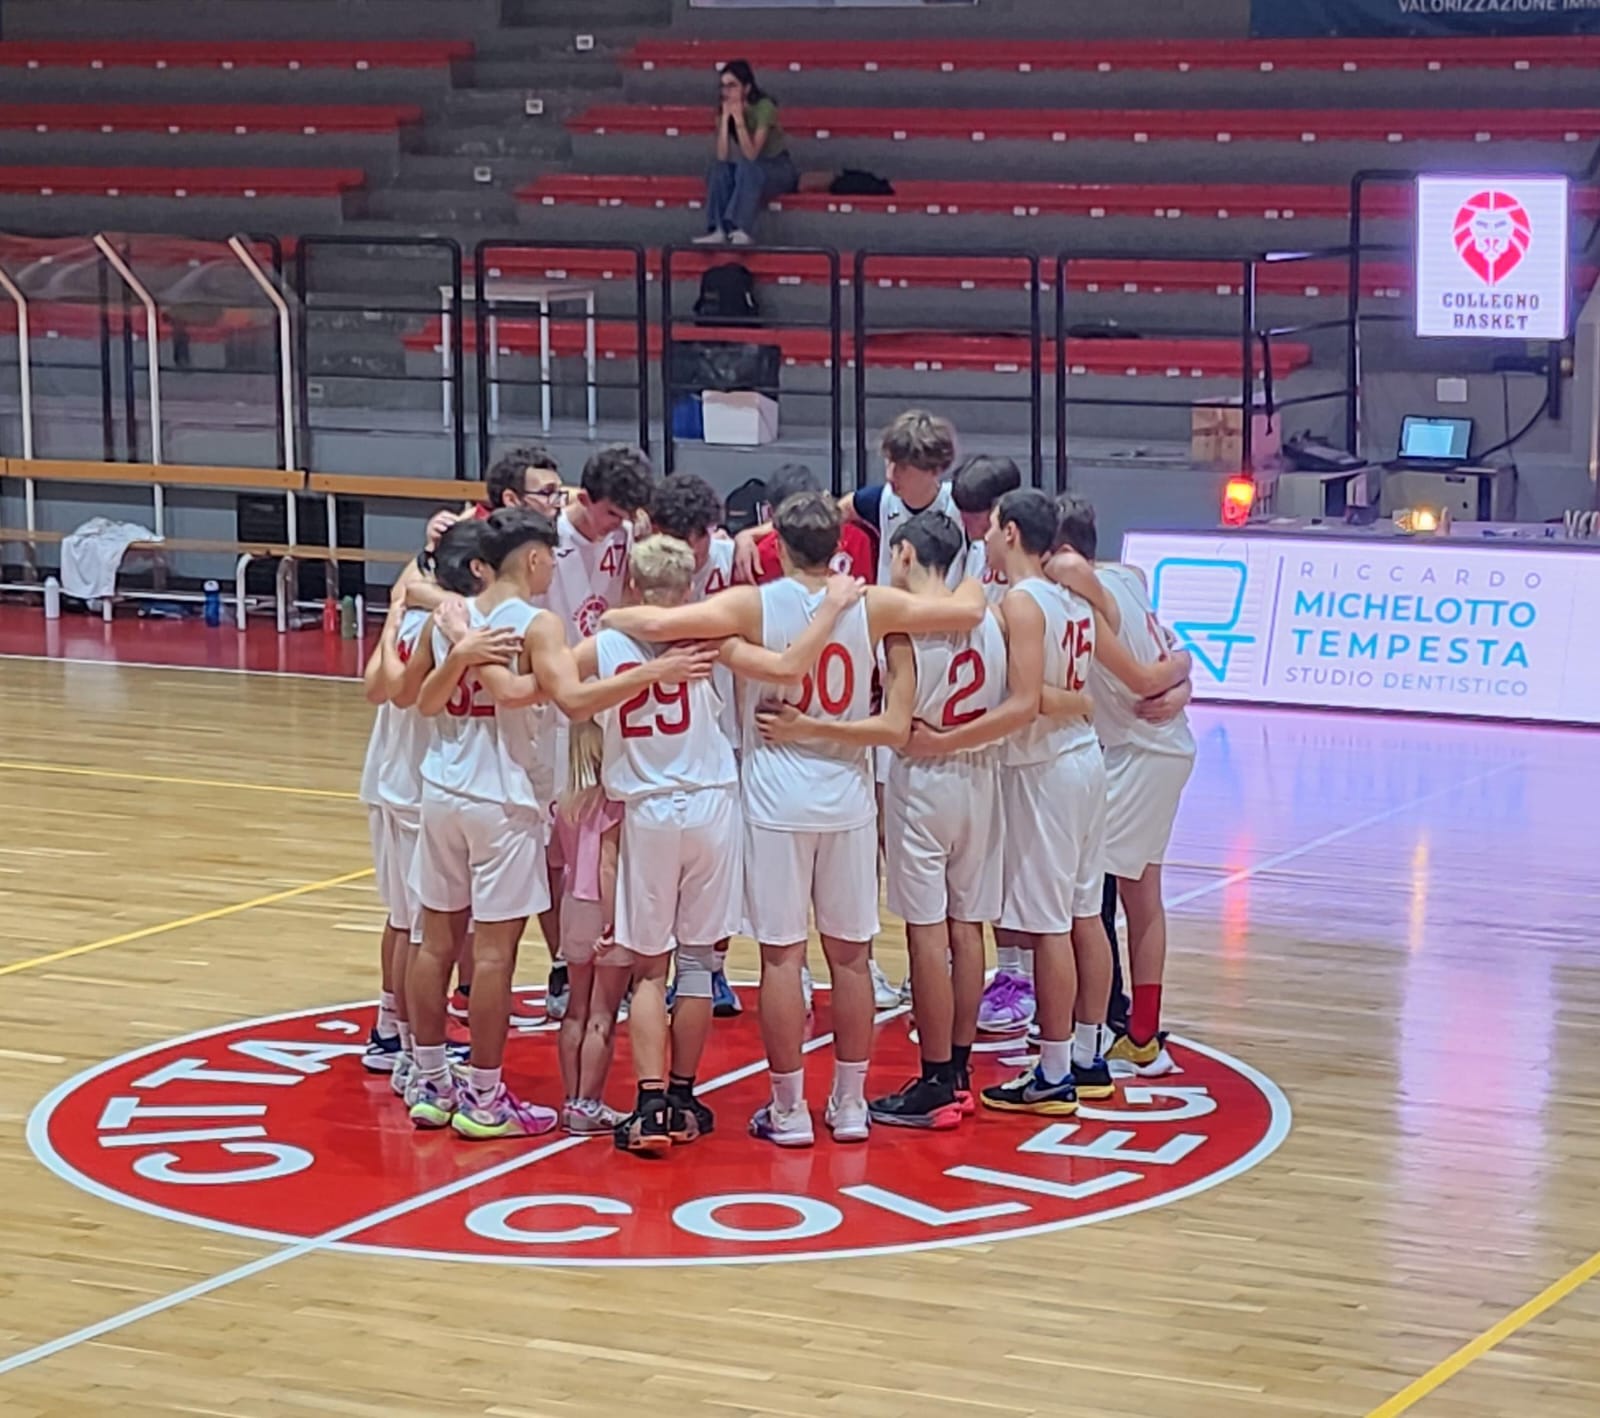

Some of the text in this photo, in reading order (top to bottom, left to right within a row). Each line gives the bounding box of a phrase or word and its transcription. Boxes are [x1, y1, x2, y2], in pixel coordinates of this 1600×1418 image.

[1399, 0, 1556, 12] VALORIZZAZIONE
[1442, 292, 1540, 310] COLLEGNO
[1453, 313, 1528, 330] BASKET
[1300, 561, 1542, 589] RICCARDO
[1294, 590, 1536, 628] MICHELOTTO
[1062, 617, 1092, 691] 15
[1291, 628, 1529, 668] TEMPESTA
[613, 661, 691, 738] 29
[941, 648, 987, 726] 2
[1285, 666, 1528, 697] STUDIO DENTISTICO
[465, 1040, 1219, 1243] COLLEG
